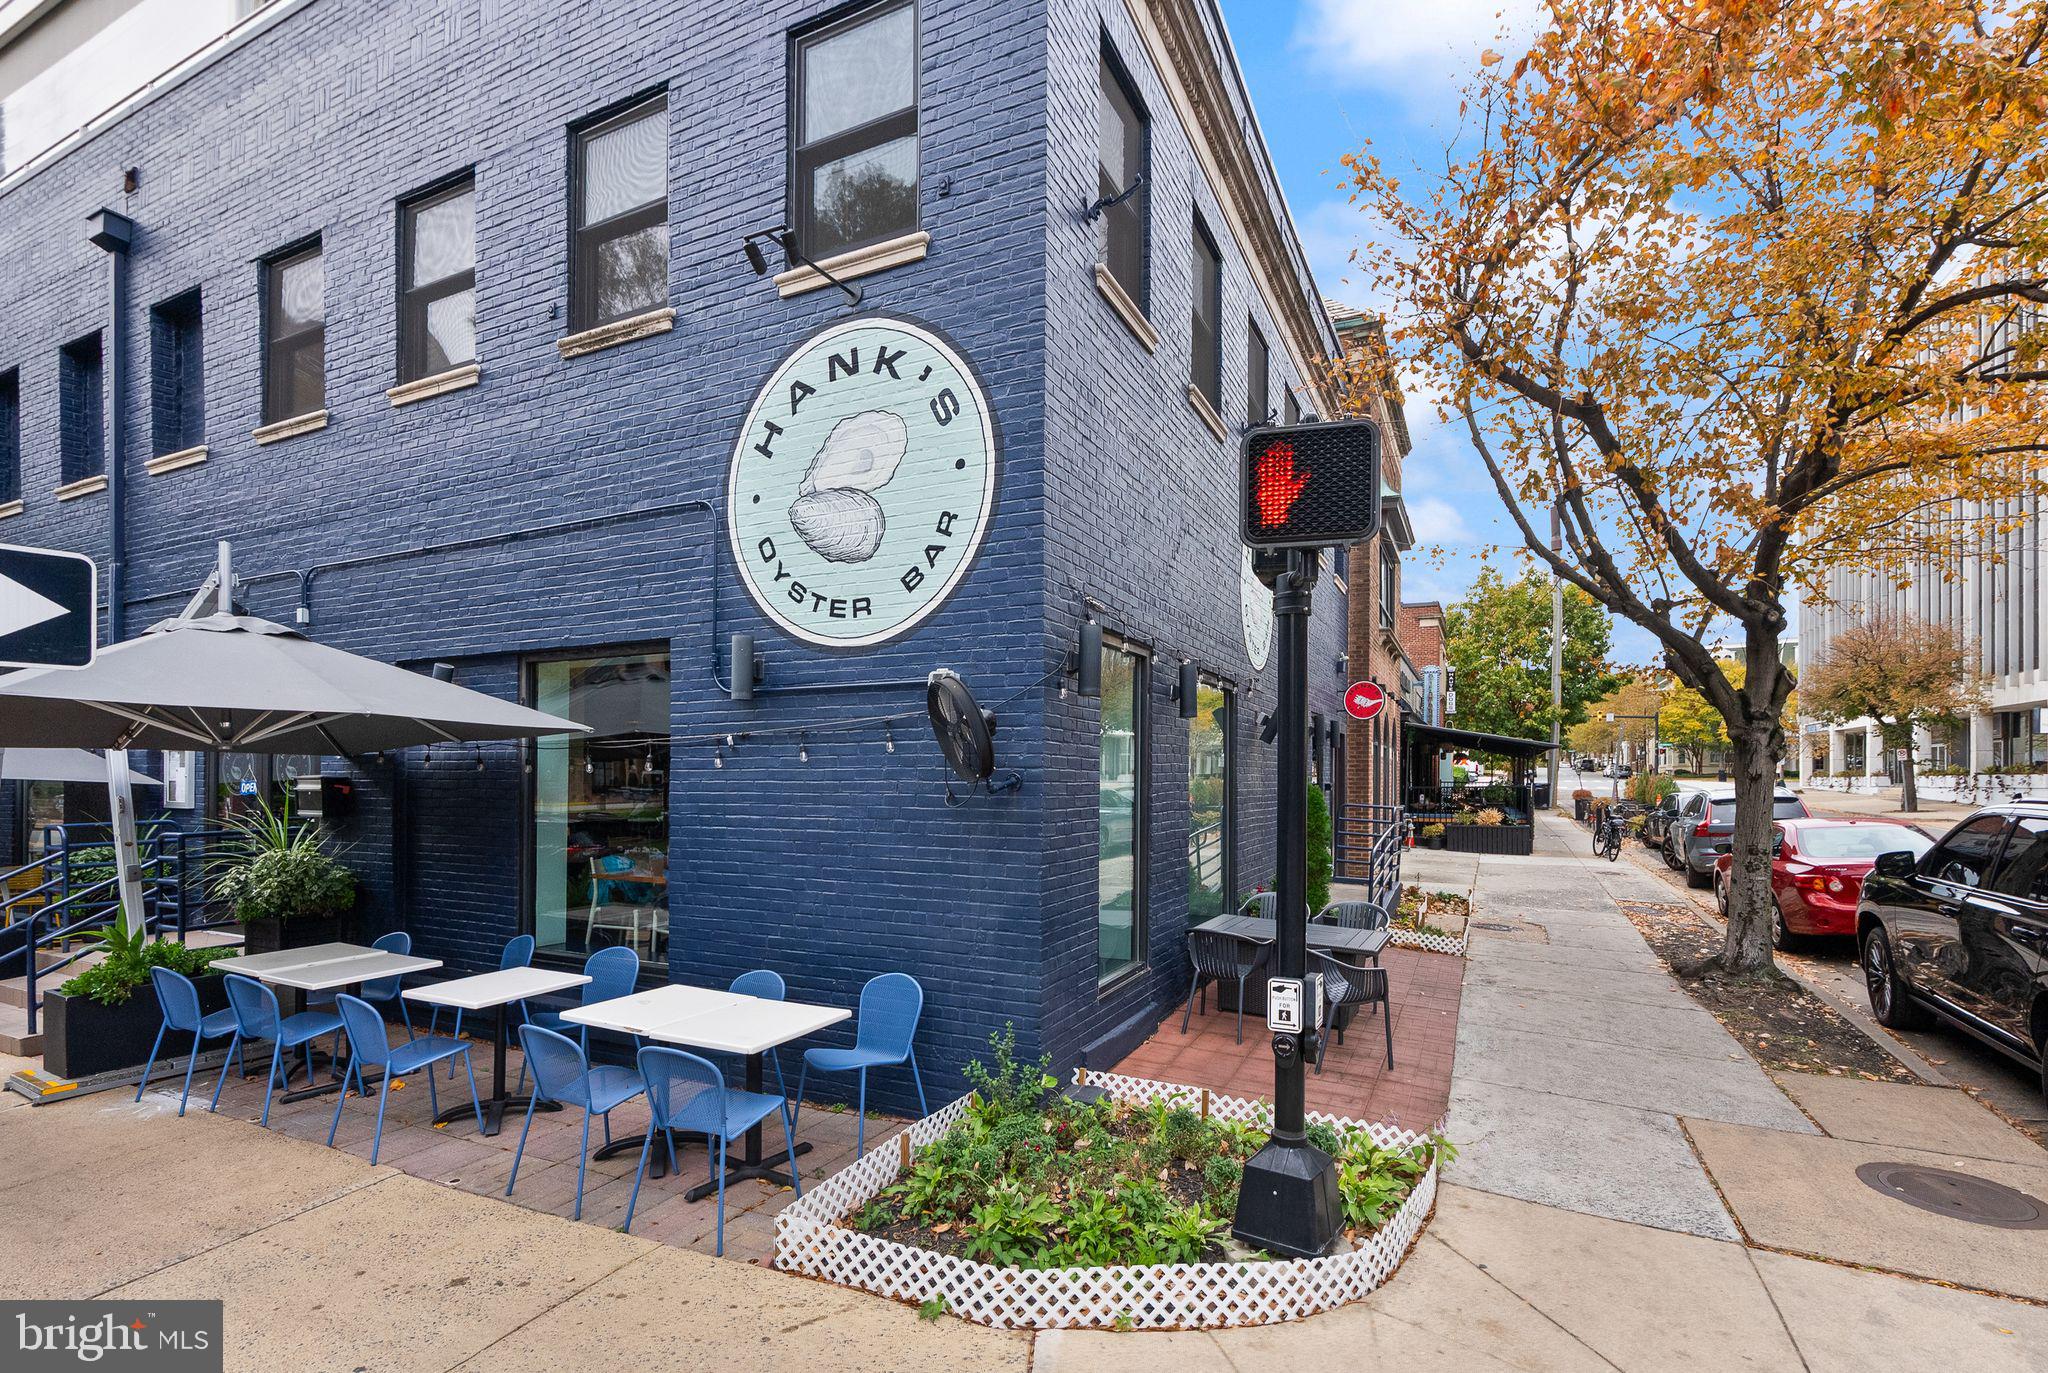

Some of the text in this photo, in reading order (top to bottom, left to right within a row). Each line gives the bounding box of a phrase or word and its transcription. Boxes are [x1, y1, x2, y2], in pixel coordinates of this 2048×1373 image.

[754, 346, 960, 459] HANK'S
[758, 510, 958, 619] OYSTER BAR
[242, 782, 257, 793] OPEN
